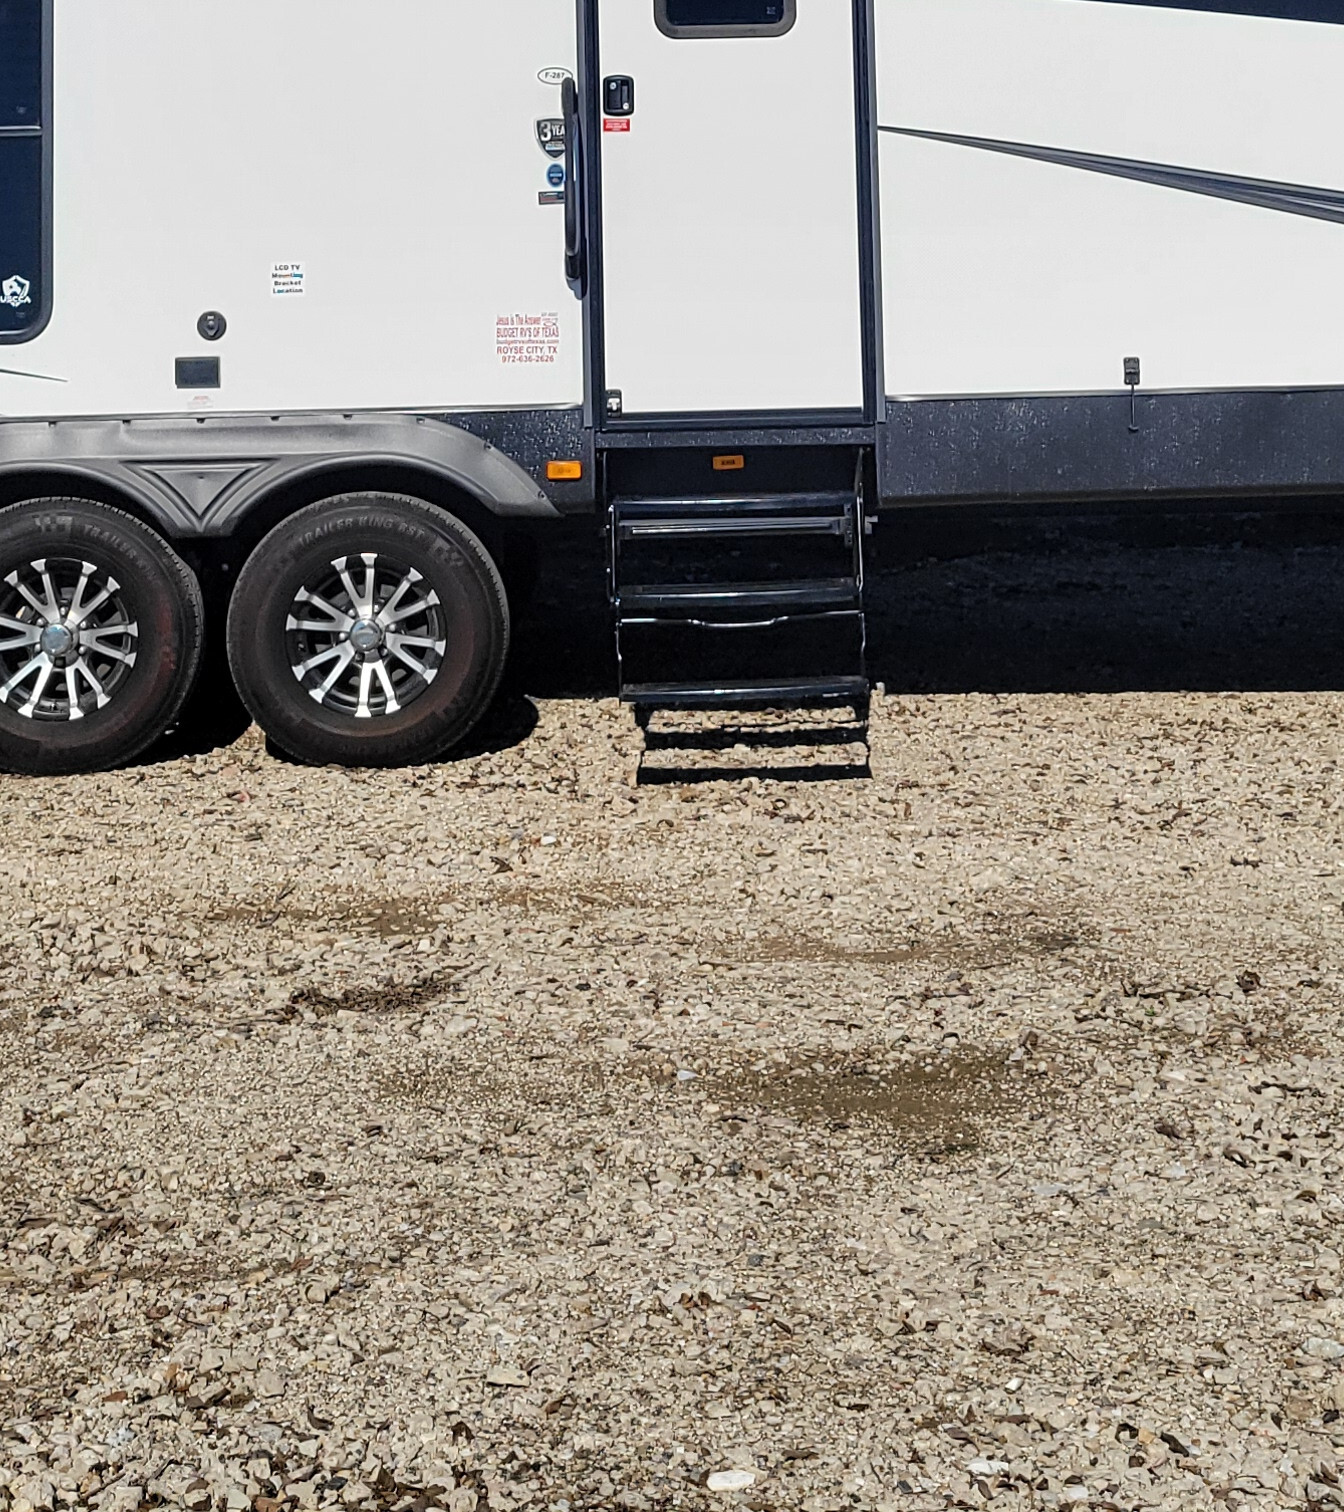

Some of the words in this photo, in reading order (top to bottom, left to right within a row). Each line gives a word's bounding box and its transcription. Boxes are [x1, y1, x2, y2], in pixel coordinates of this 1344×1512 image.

[540, 121, 552, 141] 3
[0, 295, 32, 304] USCCA
[496, 327, 518, 338] BUDGET
[533, 327, 541, 338] OF
[541, 327, 559, 338] TEXAS
[496, 346, 524, 354] ROYSE
[547, 346, 558, 354] TX
[501, 354, 555, 363] 972-636-2626
